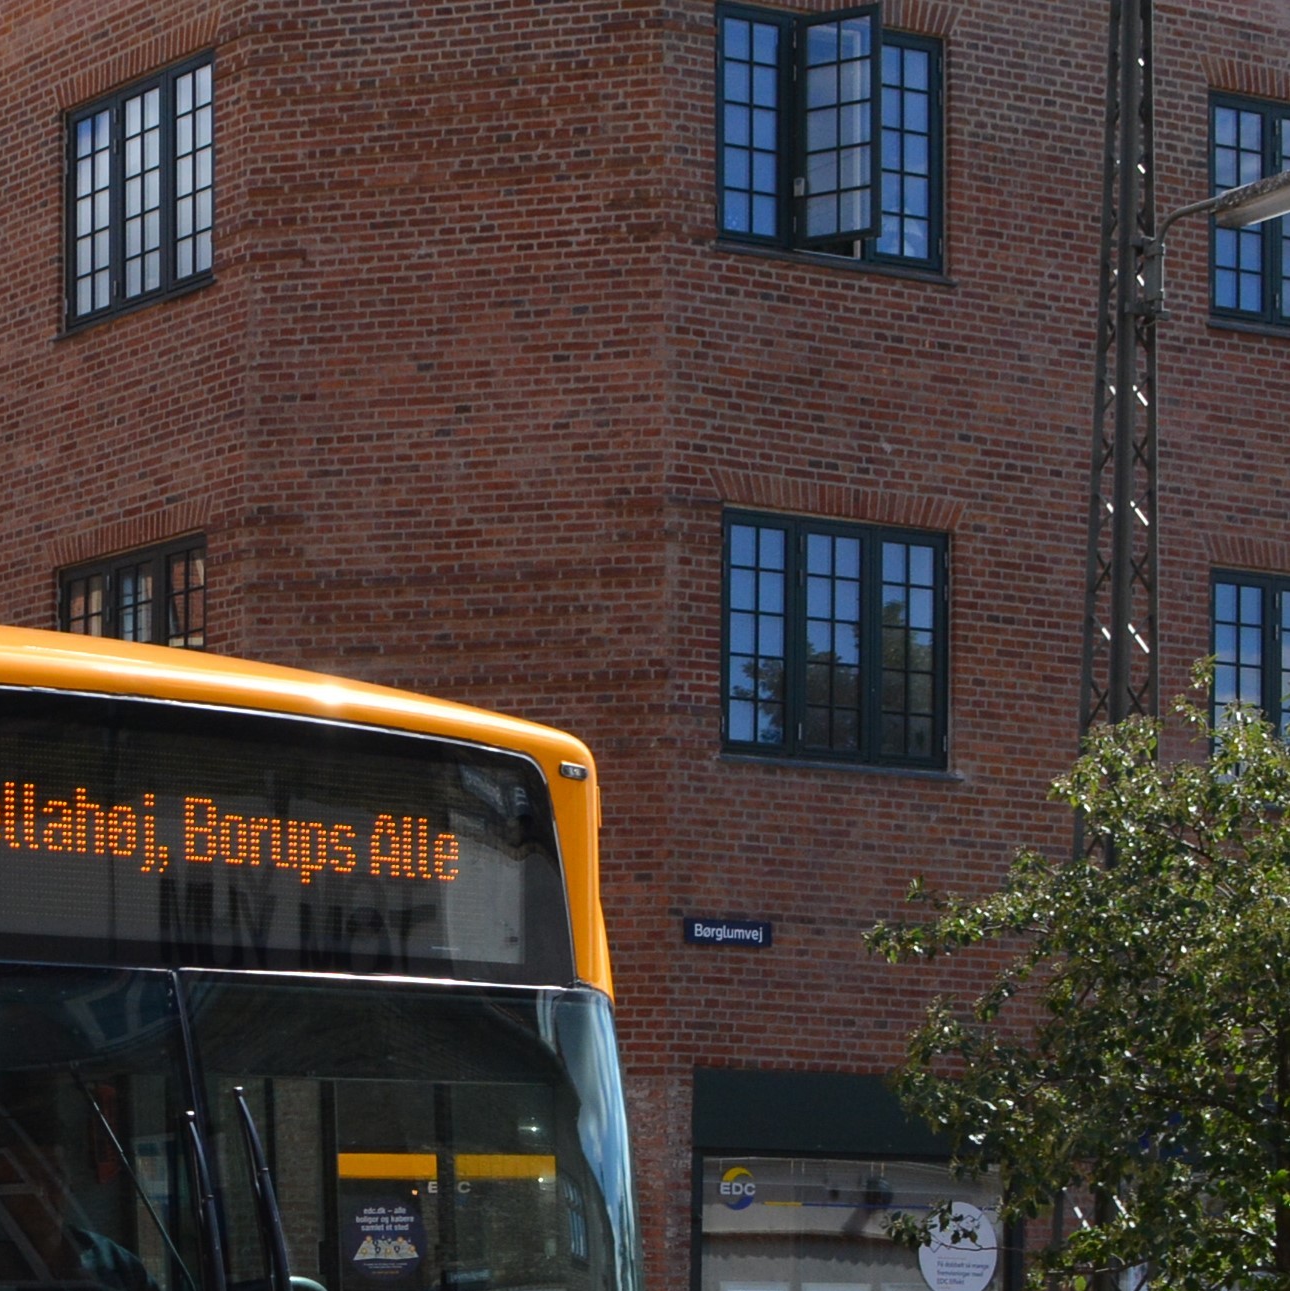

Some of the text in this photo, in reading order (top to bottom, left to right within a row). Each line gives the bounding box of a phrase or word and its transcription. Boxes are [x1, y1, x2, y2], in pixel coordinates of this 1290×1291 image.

[183, 795, 356, 885] Borups
[369, 813, 460, 884] Alle
[694, 923, 763, 943] Børglumvej
[427, 1181, 471, 1194] EC
[720, 1182, 756, 1196] EDC
